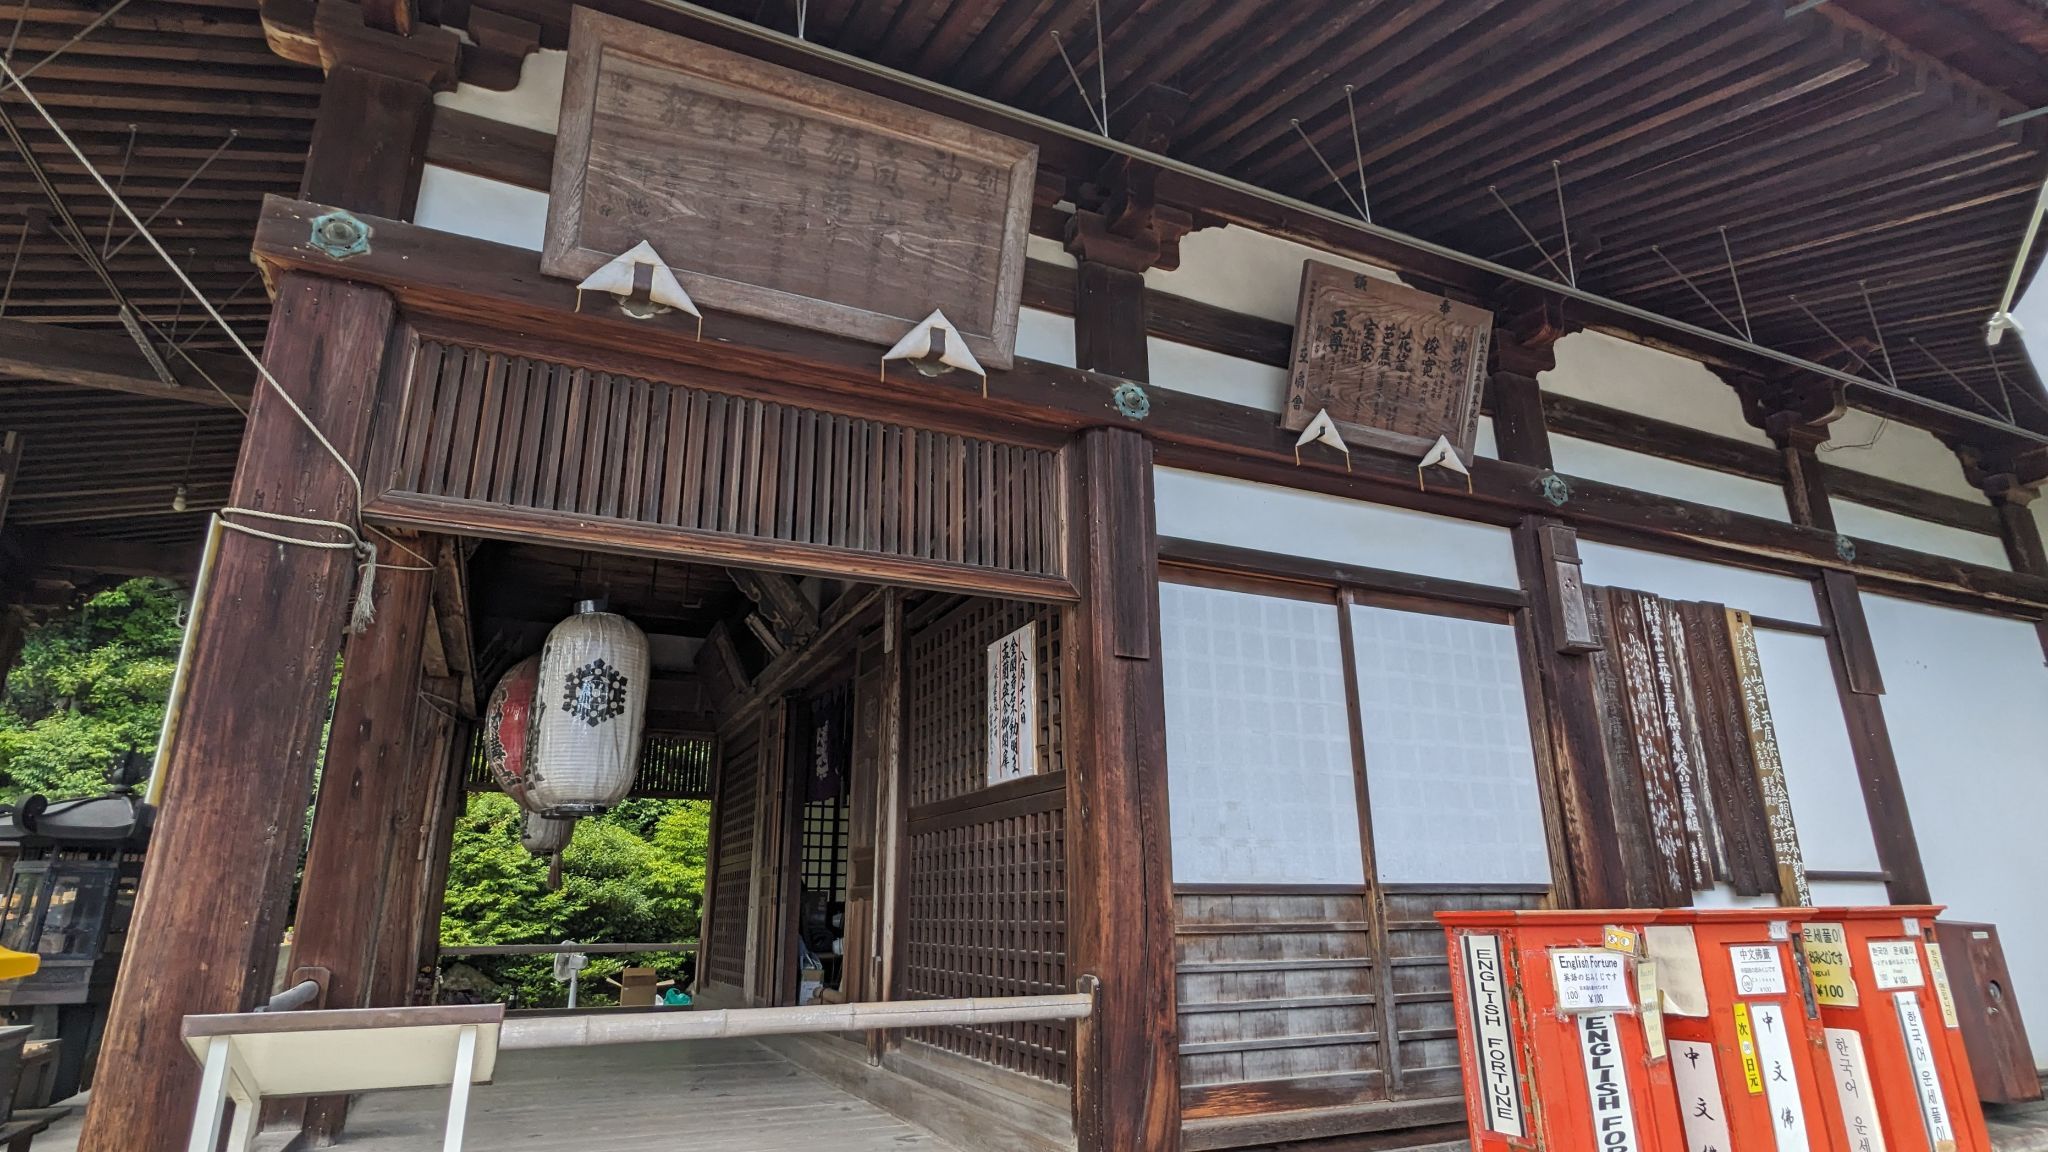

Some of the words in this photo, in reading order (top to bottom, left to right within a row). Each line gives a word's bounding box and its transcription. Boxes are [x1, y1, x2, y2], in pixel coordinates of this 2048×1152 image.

[1020, 651, 1028, 724] 八月十六日
[1559, 956, 1590, 970] English
[1590, 956, 1618, 968] Fortune
[1803, 928, 1842, 943] 운세풀이
[1476, 949, 1501, 1027] ENGLISH
[1563, 973, 1617, 982] 英語のおみくじです
[1588, 993, 1603, 1003] ¥100
[1815, 984, 1844, 998] ¥100
[1585, 1016, 1621, 1111] ENGLISH
[1736, 1012, 1749, 1036] 一次
[1746, 1058, 1759, 1088] 日元
[1907, 1011, 1927, 1063] 한국어
[1488, 1037, 1514, 1121] FORTUNE
[1835, 1038, 1859, 1099] 한국어
